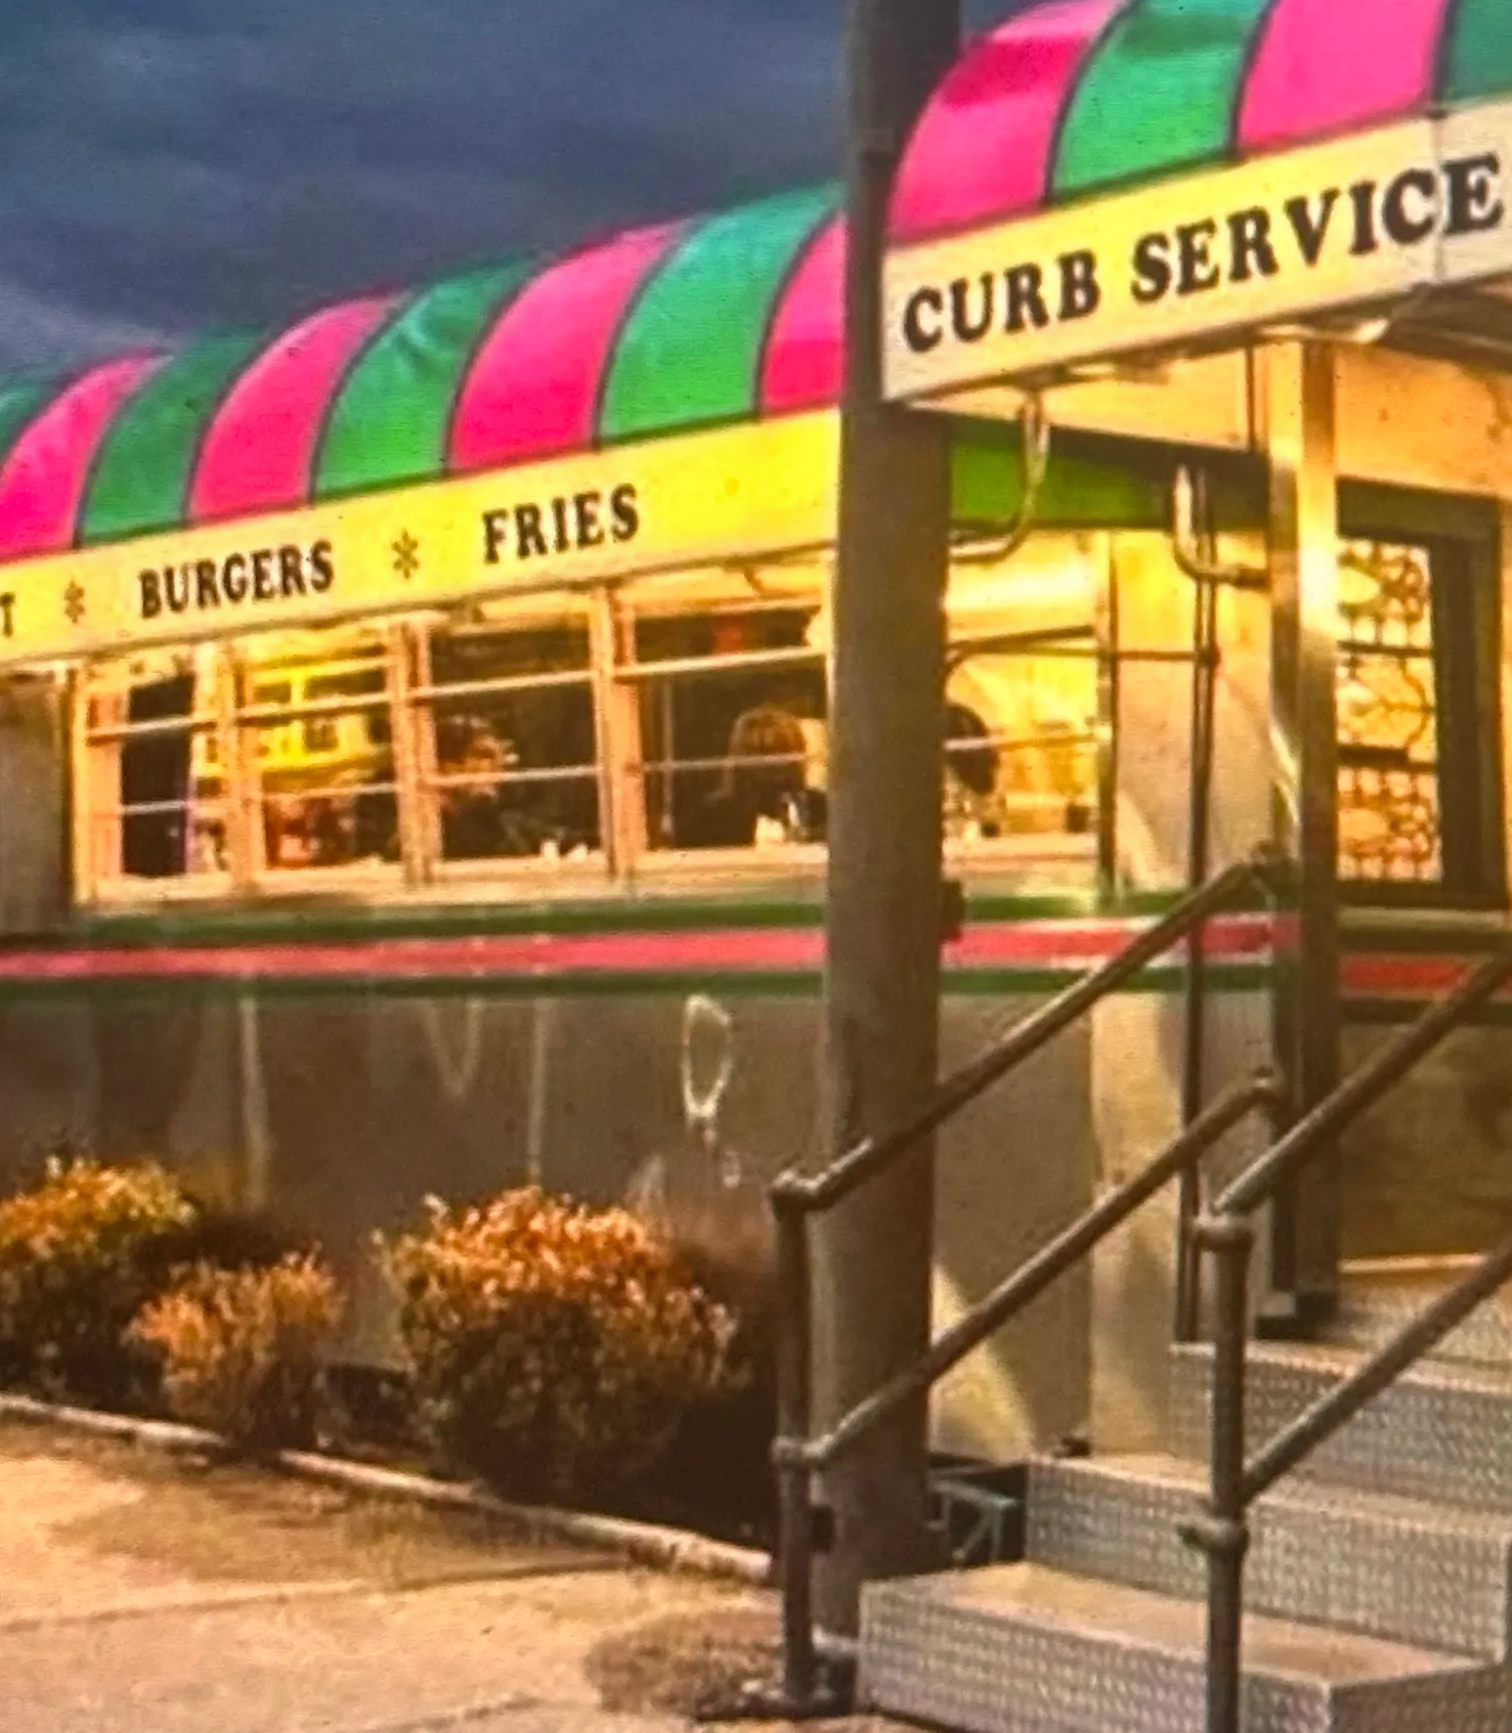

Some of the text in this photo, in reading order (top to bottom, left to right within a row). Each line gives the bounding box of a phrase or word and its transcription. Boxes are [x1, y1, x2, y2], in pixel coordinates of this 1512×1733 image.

[904, 153, 1503, 353] CURB SERVICE
[139, 540, 334, 619] BURGERS
[484, 486, 638, 563] FRIES
